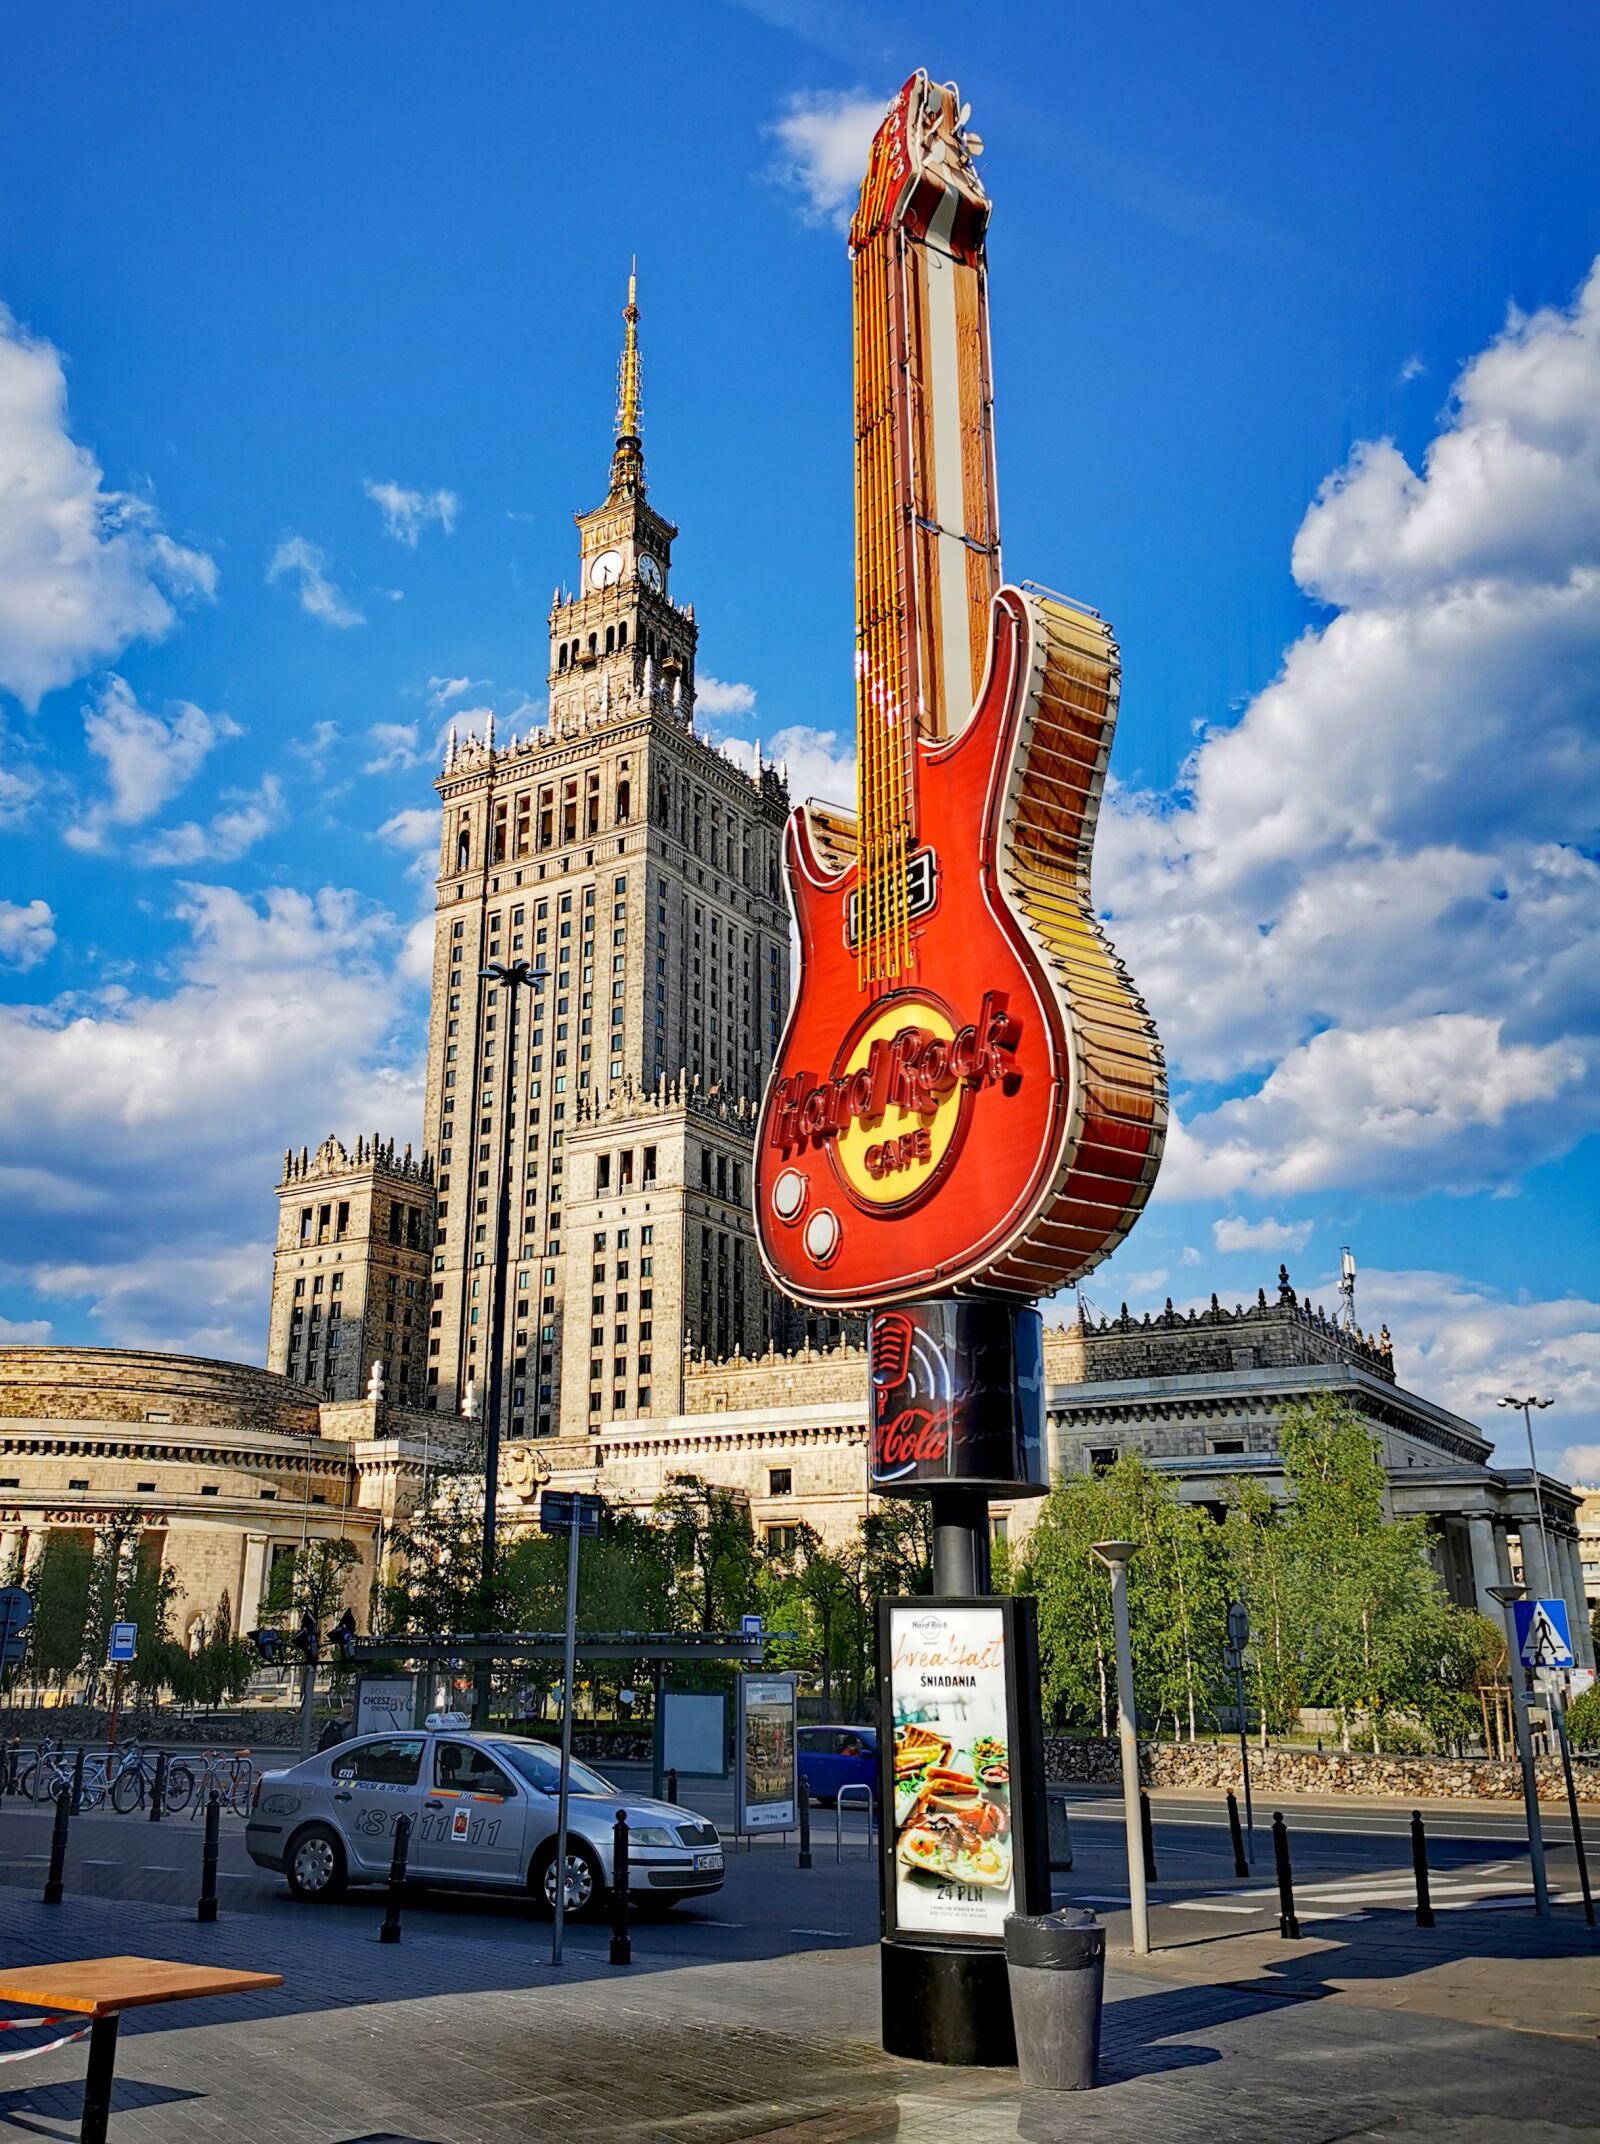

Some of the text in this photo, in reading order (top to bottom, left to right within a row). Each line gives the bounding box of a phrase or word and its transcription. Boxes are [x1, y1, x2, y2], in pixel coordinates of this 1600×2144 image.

[771, 989, 1024, 1150] Hard Rock
[864, 1126, 932, 1174] CAFE
[43, 1510, 170, 1527] KONGRWA
[912, 1621, 948, 1630] Hard Rock
[891, 1633, 1004, 1675] breakfast
[920, 1672, 977, 1688] ŚNIADANIA
[363, 1696, 391, 1705] CHCESZ
[937, 1884, 983, 1901] 24 PLN
